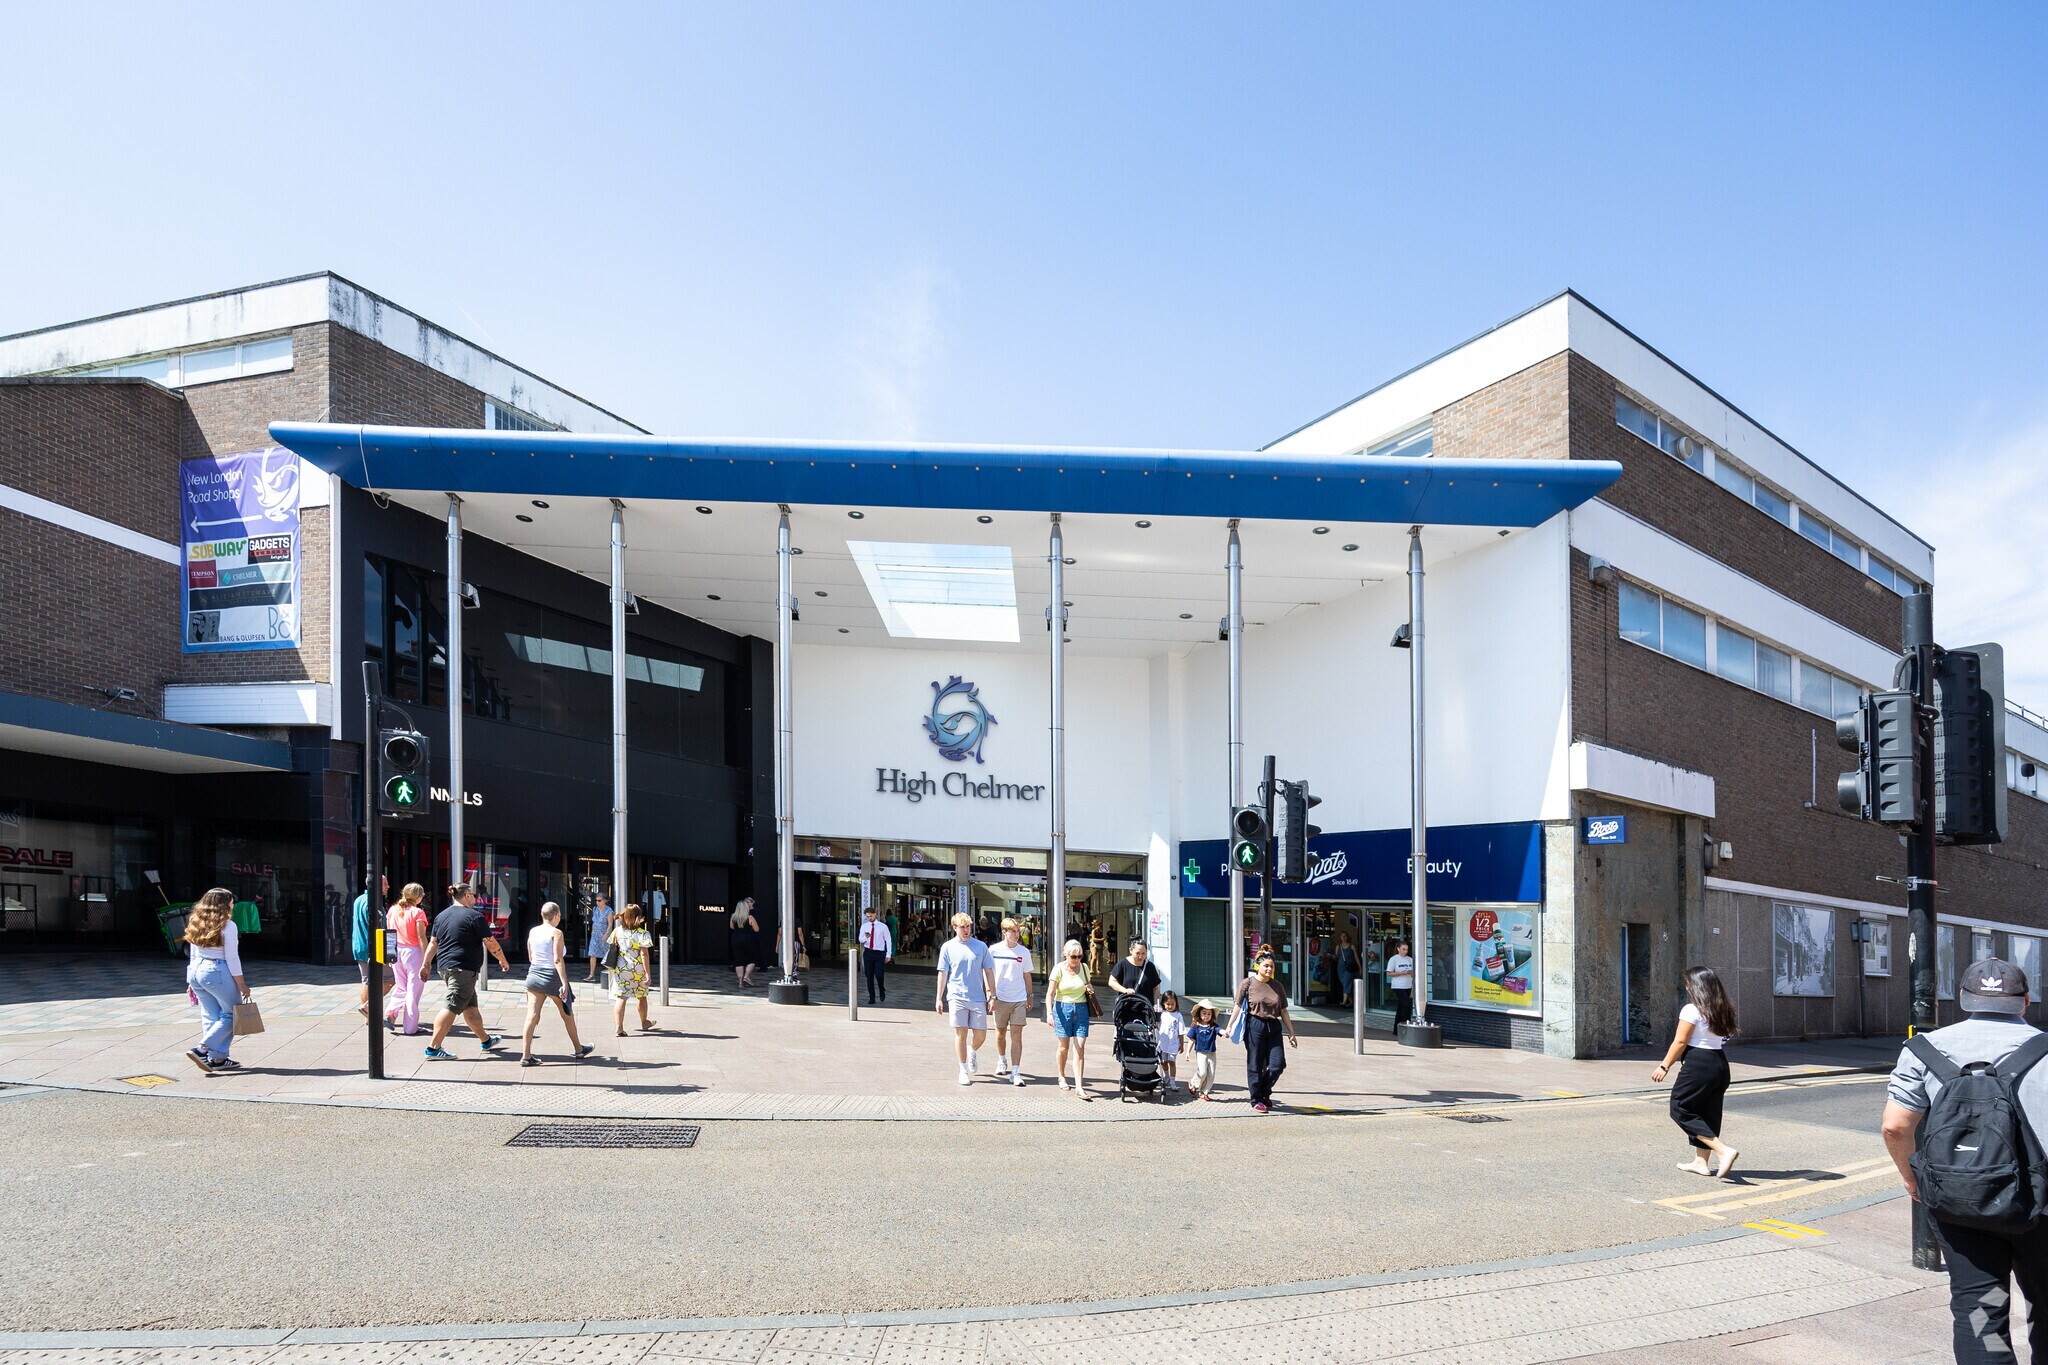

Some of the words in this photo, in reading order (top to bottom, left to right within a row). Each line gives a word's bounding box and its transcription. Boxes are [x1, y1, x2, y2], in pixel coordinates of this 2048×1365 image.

[187, 474, 209, 486] New
[210, 468, 243, 484] London
[187, 489, 211, 504] Road
[213, 488, 241, 502] Shops
[189, 540, 247, 560] SUBWAY
[249, 537, 290, 551] GADGETS
[240, 633, 266, 641] OLUFSEN
[875, 767, 936, 803] High
[942, 771, 1046, 801] Chelmer
[1588, 821, 1619, 838] Boots
[0, 846, 73, 868] SALE
[230, 861, 274, 877] SALE
[1476, 918, 1490, 927] 1/2
